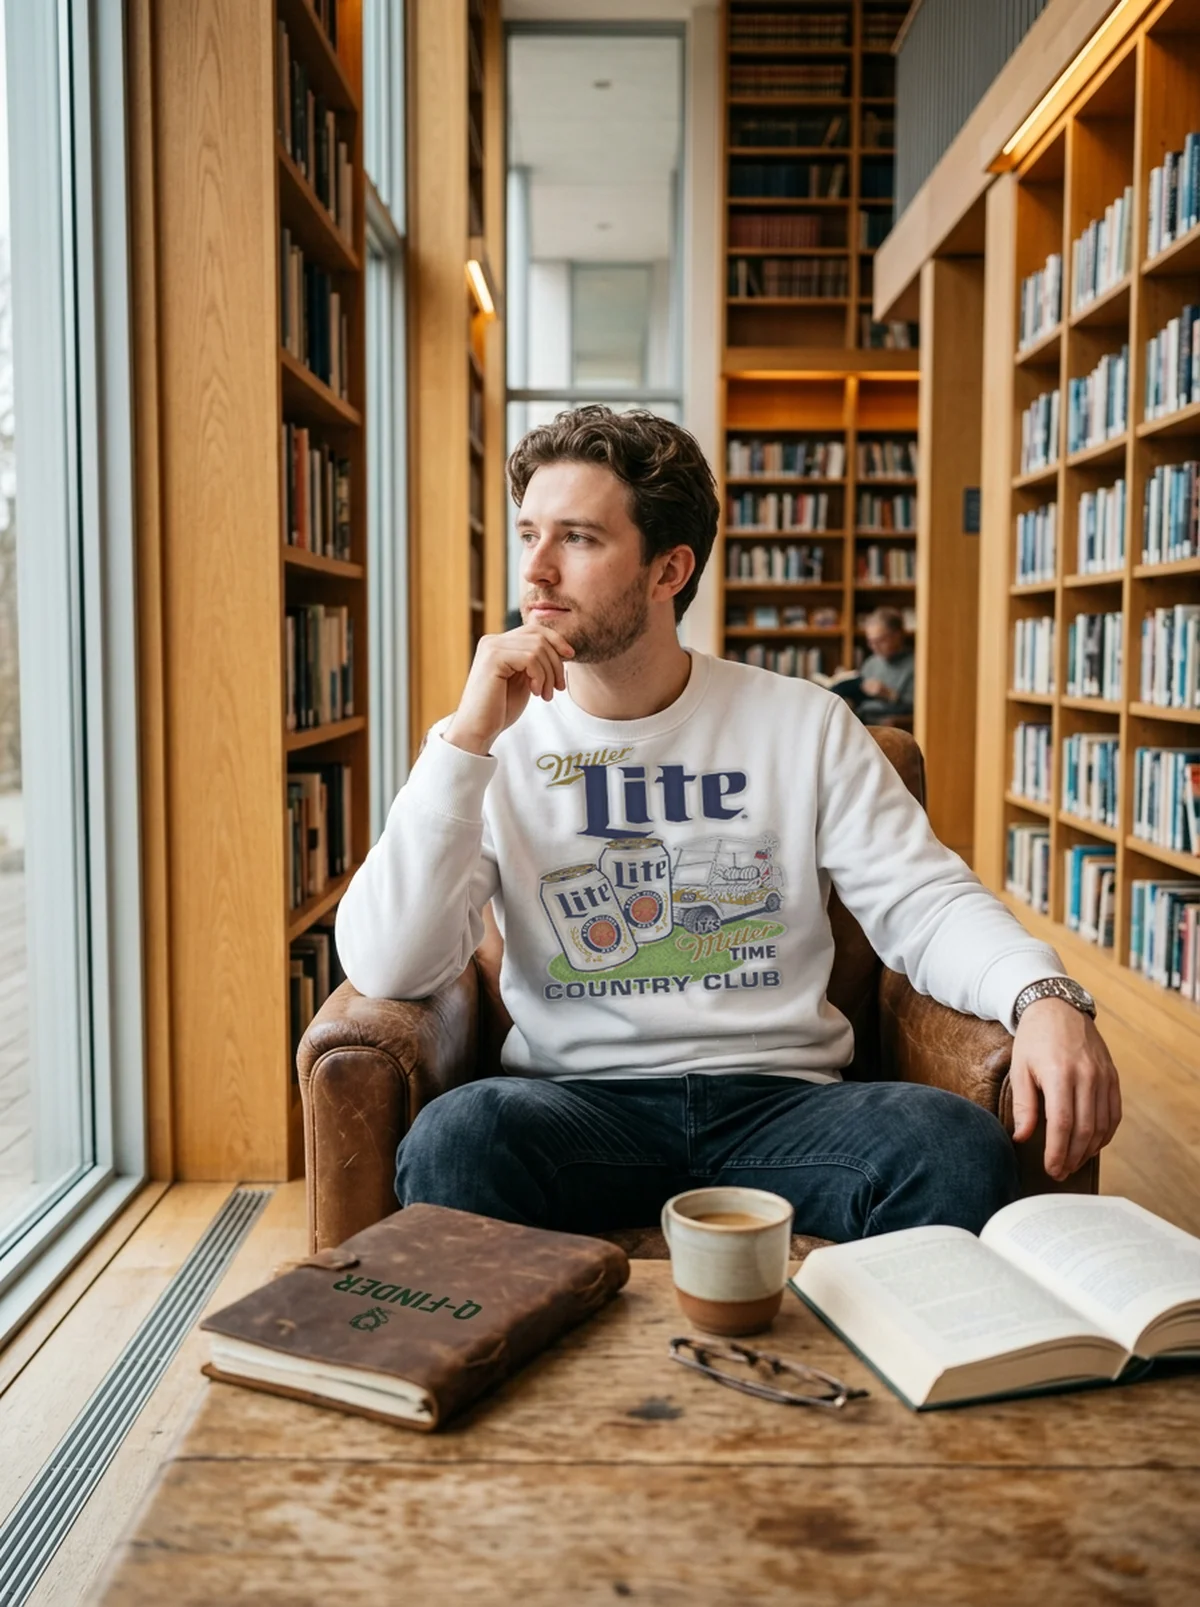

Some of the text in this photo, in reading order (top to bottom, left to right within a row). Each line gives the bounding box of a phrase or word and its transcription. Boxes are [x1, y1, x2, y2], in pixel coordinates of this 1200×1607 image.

[536, 747, 633, 786] Miller
[573, 765, 746, 838] Lite
[612, 861, 666, 889] Lite
[555, 883, 610, 918] Lite
[676, 924, 776, 962] Miller
[729, 945, 776, 960] TIME
[545, 971, 780, 999] COUNTRY CLUB
[333, 1274, 483, 1320] Q-FINDER
